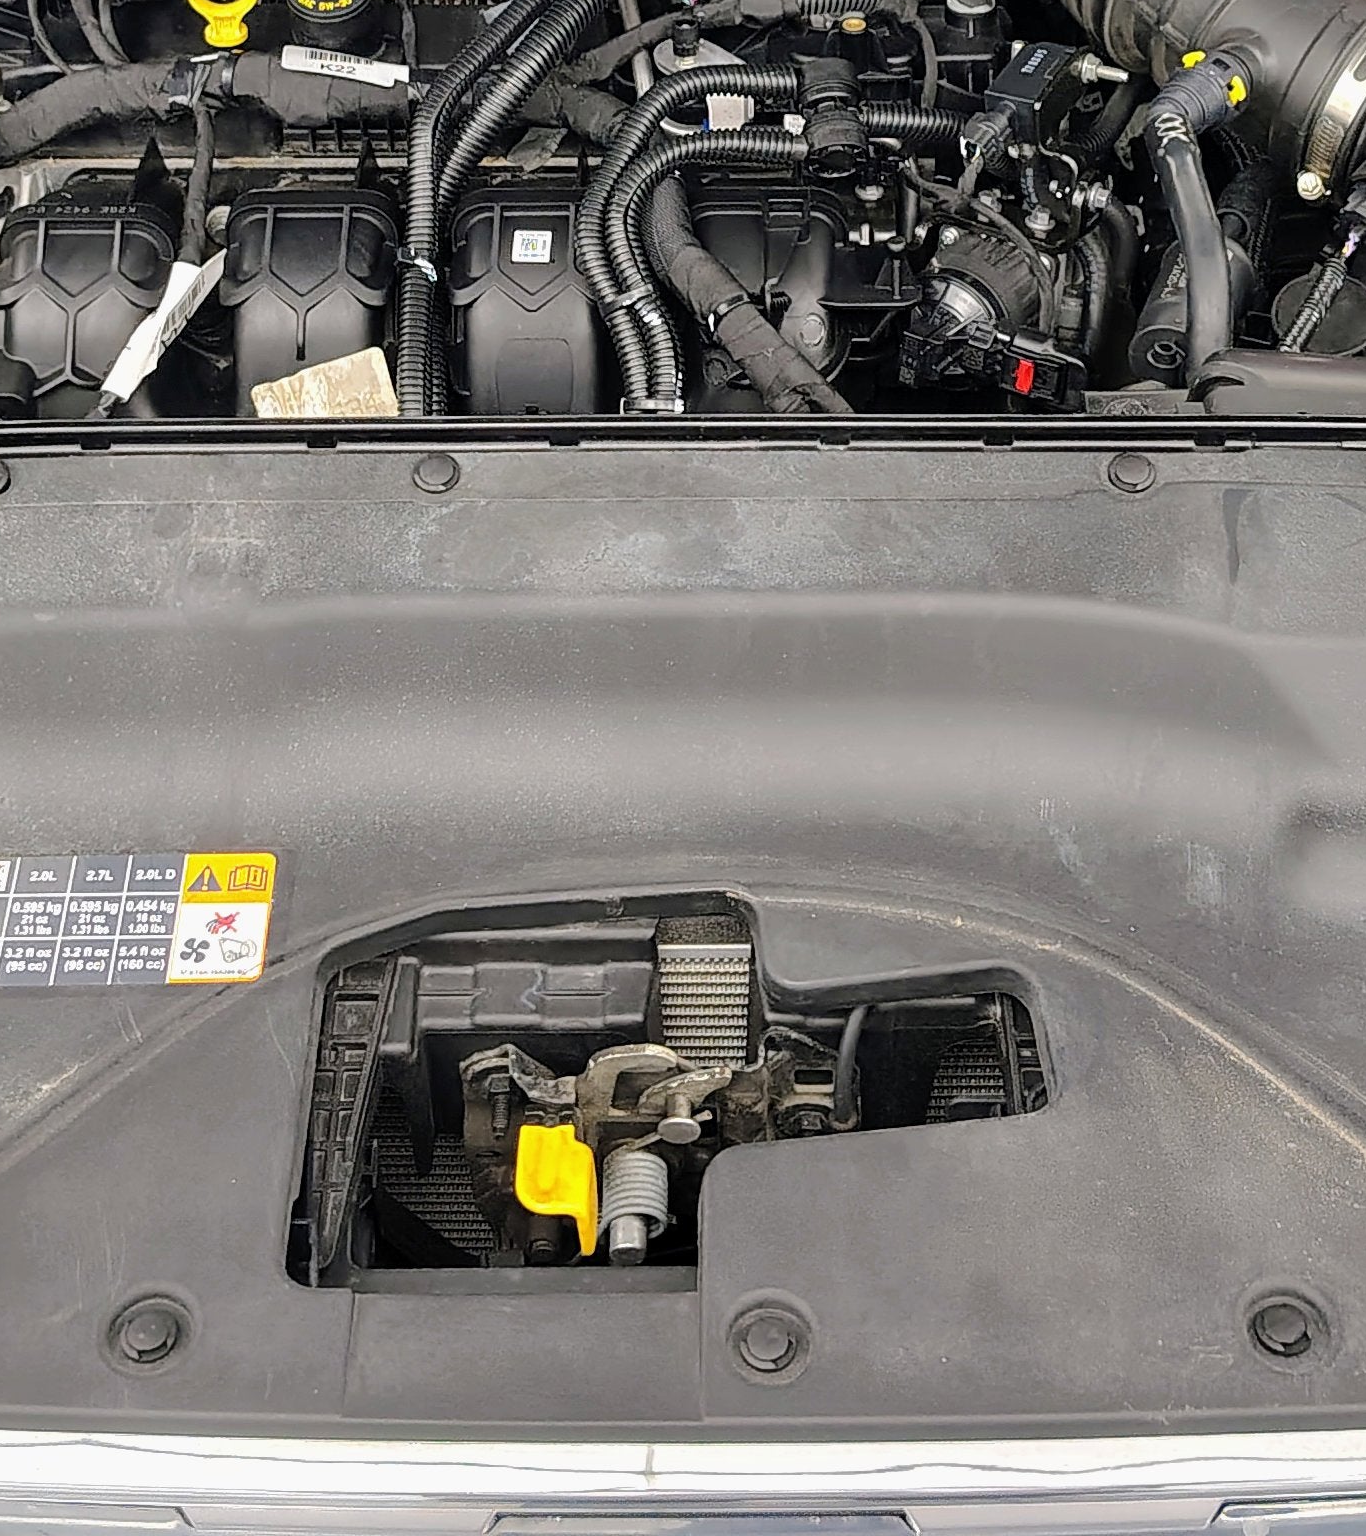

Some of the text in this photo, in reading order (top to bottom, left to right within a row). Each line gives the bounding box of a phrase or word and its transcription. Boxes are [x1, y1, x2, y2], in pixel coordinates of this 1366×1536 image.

[320, 63, 356, 75] K22
[29, 870, 57, 882] 2.0L
[85, 869, 114, 882] 2.7L
[134, 868, 177, 881] 2.0L D
[46, 901, 63, 915] kg
[103, 900, 120, 916] kg
[125, 899, 176, 914] 0.454 kg
[20, 915, 49, 925] 21 oz
[77, 914, 107, 924] 21 oz
[149, 914, 163, 923] oz
[4, 947, 52, 959] 3.2 fl oz
[62, 946, 110, 958] 3.2 fl oz
[118, 945, 166, 957] 5.4 fl oz
[5, 960, 47, 974] (95 cc)
[85, 959, 106, 973] cc)
[145, 958, 165, 972] cc)
